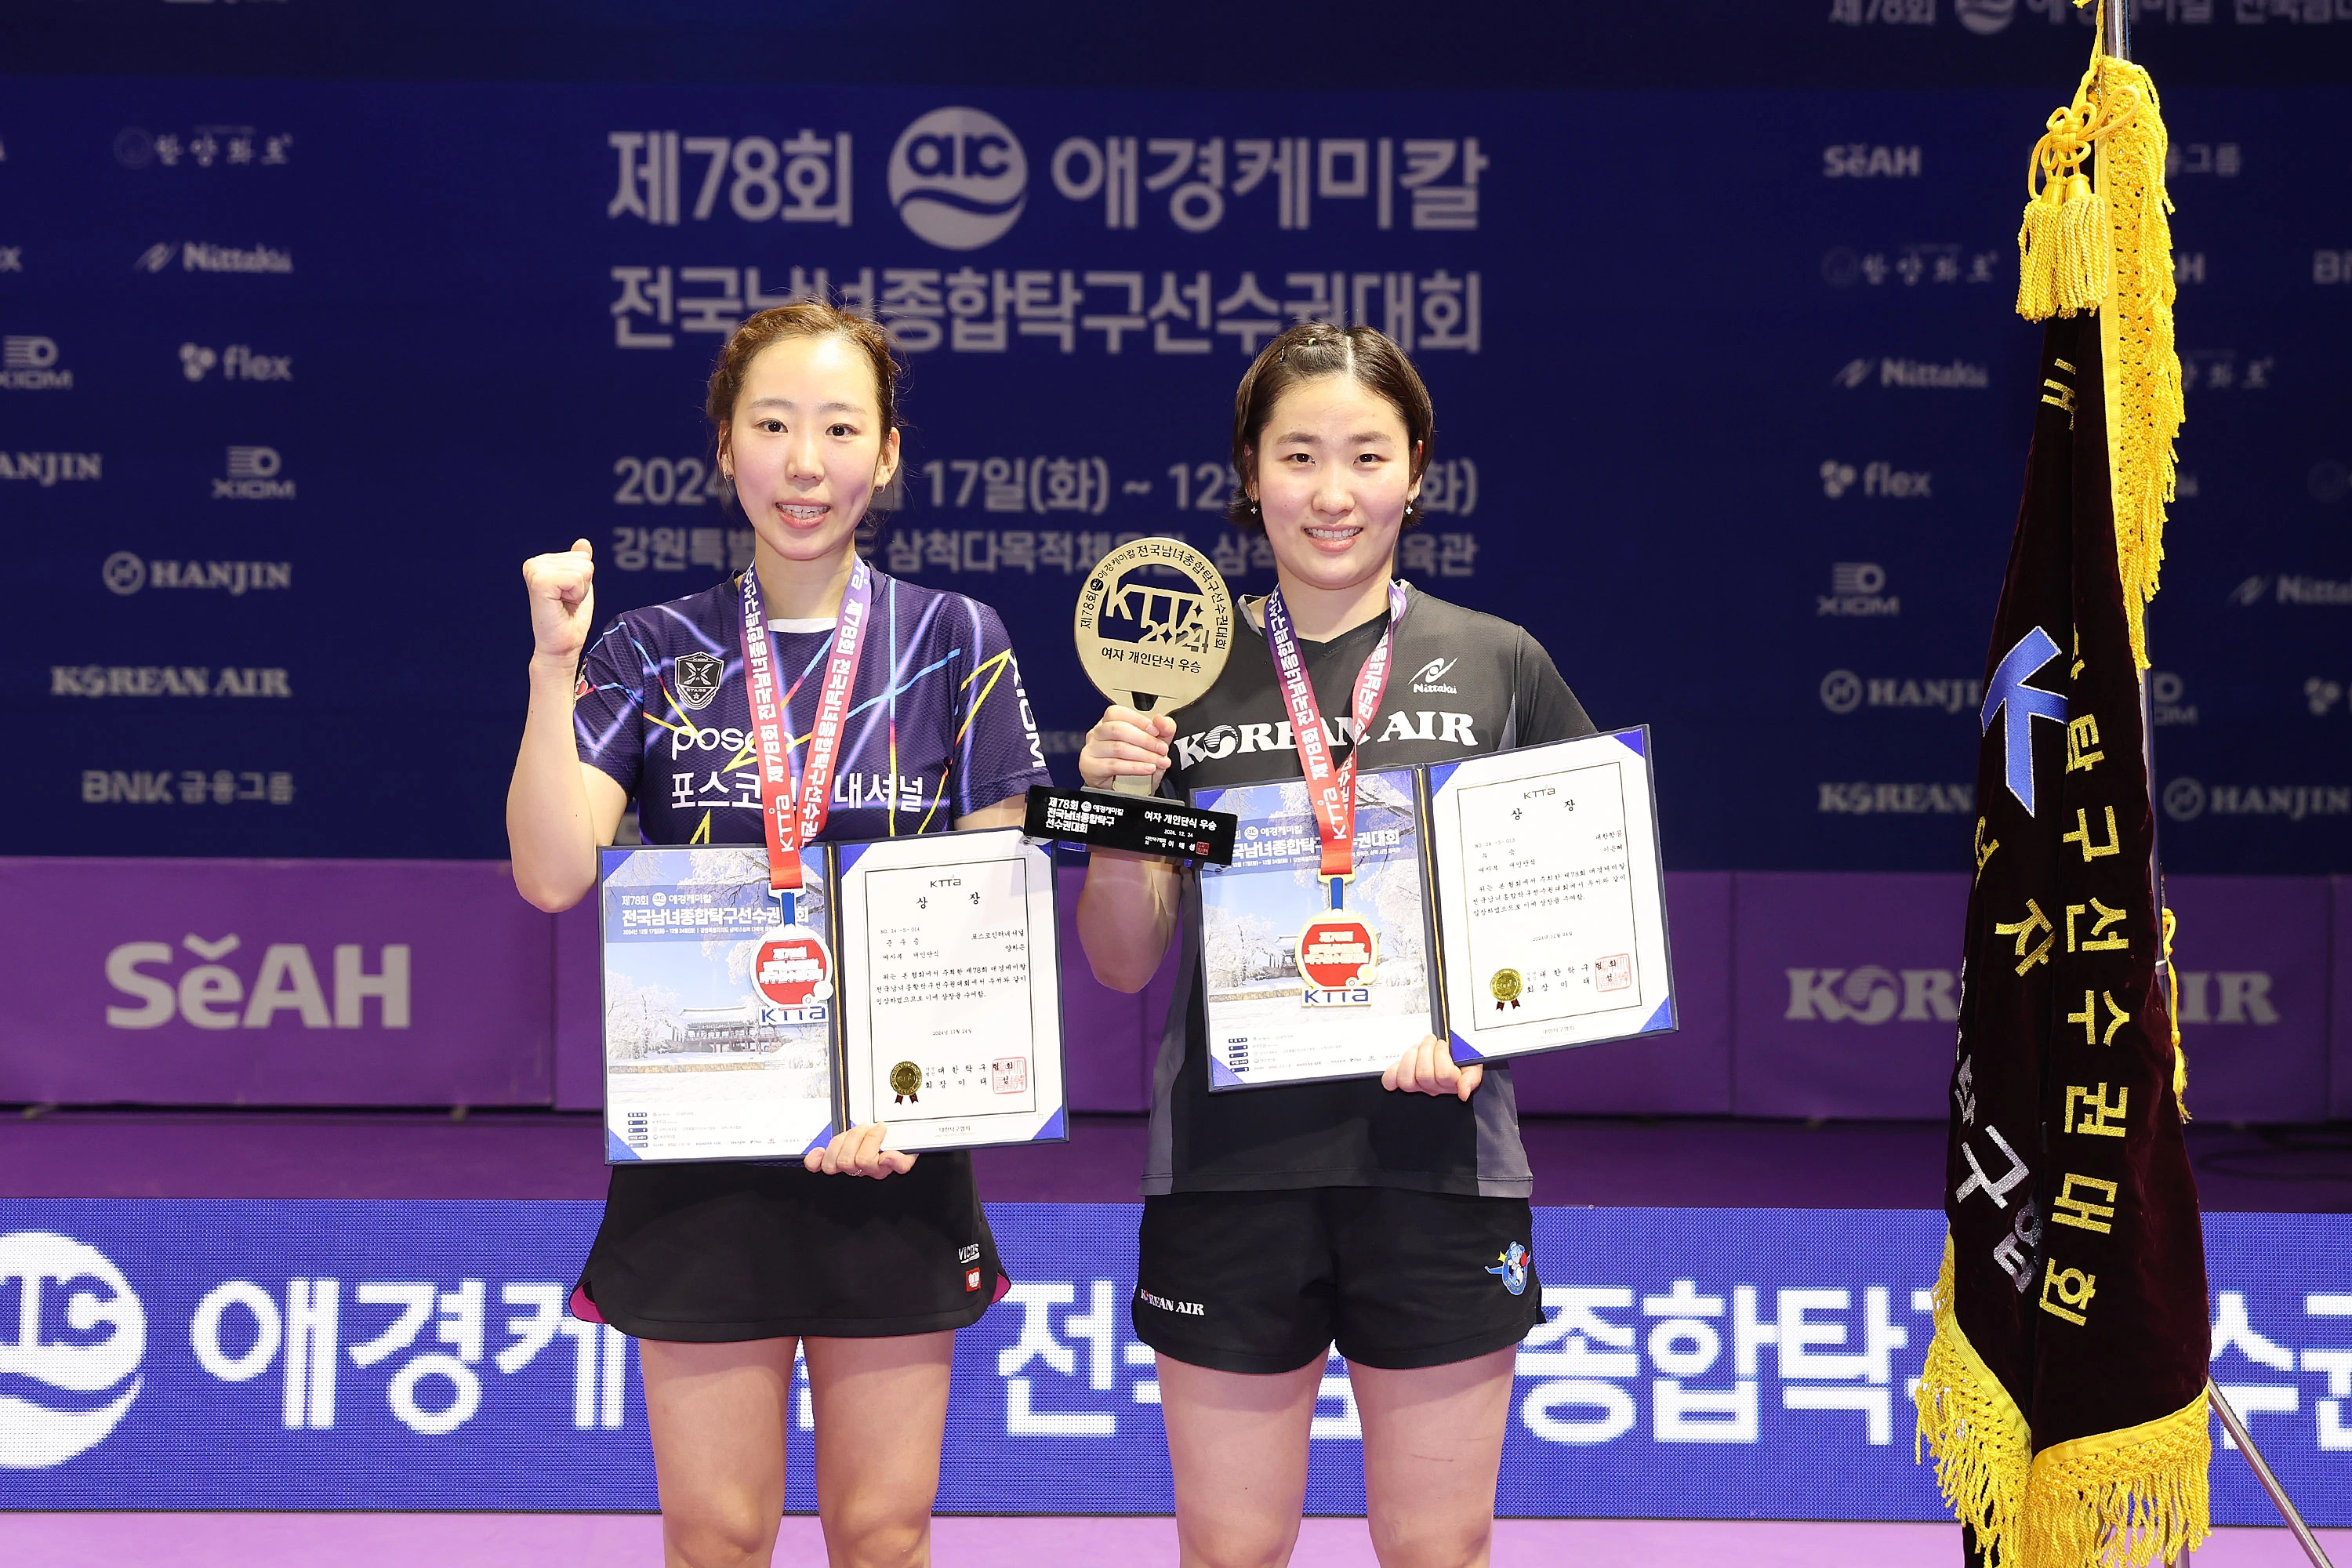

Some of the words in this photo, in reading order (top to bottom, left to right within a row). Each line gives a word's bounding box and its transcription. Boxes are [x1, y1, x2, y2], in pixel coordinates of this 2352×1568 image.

[608, 129, 853, 227] 제78회
[1051, 136, 1488, 233] 애경케미칼
[223, 345, 293, 381] flex
[0, 452, 103, 487] ANJIN
[1864, 461, 1931, 498] flex
[212, 479, 296, 499] XIOM
[150, 561, 291, 596] HANJIN
[2277, 575, 2352, 604] Nitta
[1080, 590, 1099, 629] 제78회
[1098, 550, 1136, 579] 애경케미칼
[1137, 544, 1229, 650] 전국남녀종합탁구선수권대회
[1817, 595, 1900, 615] XIOM
[836, 597, 864, 655] 제78회
[1102, 647, 1124, 662] 여자
[1128, 652, 1174, 670] 개인단식
[1178, 659, 1201, 673] 우승
[50, 665, 209, 697] KOREAN
[213, 666, 292, 697] AIR
[1413, 683, 1457, 695] Nittaku
[1867, 677, 1981, 713] HANJI
[1377, 710, 1479, 746] AIR
[760, 724, 785, 783] 제78회
[1301, 727, 1329, 781] 제78회
[82, 770, 173, 804] BNK
[177, 770, 295, 804] 금융그룹
[671, 771, 923, 812] 포스코내셔널
[1047, 807, 1115, 827] 전국남녀종합탁구
[1048, 797, 1079, 811] 제78회
[1045, 818, 1088, 834] 선수권대회
[1145, 811, 1162, 823] 여자
[1163, 814, 1197, 829] 개인단식
[1200, 819, 1217, 831] 우승
[1260, 825, 1303, 837] 애경케미칼
[621, 895, 649, 906] 제78회
[668, 893, 712, 905] 애경케미칼
[622, 906, 809, 927] 전국남녀종합탁구선수권회
[1141, 1288, 1174, 1311] KOREAN
[1176, 1301, 1205, 1316] AIR
